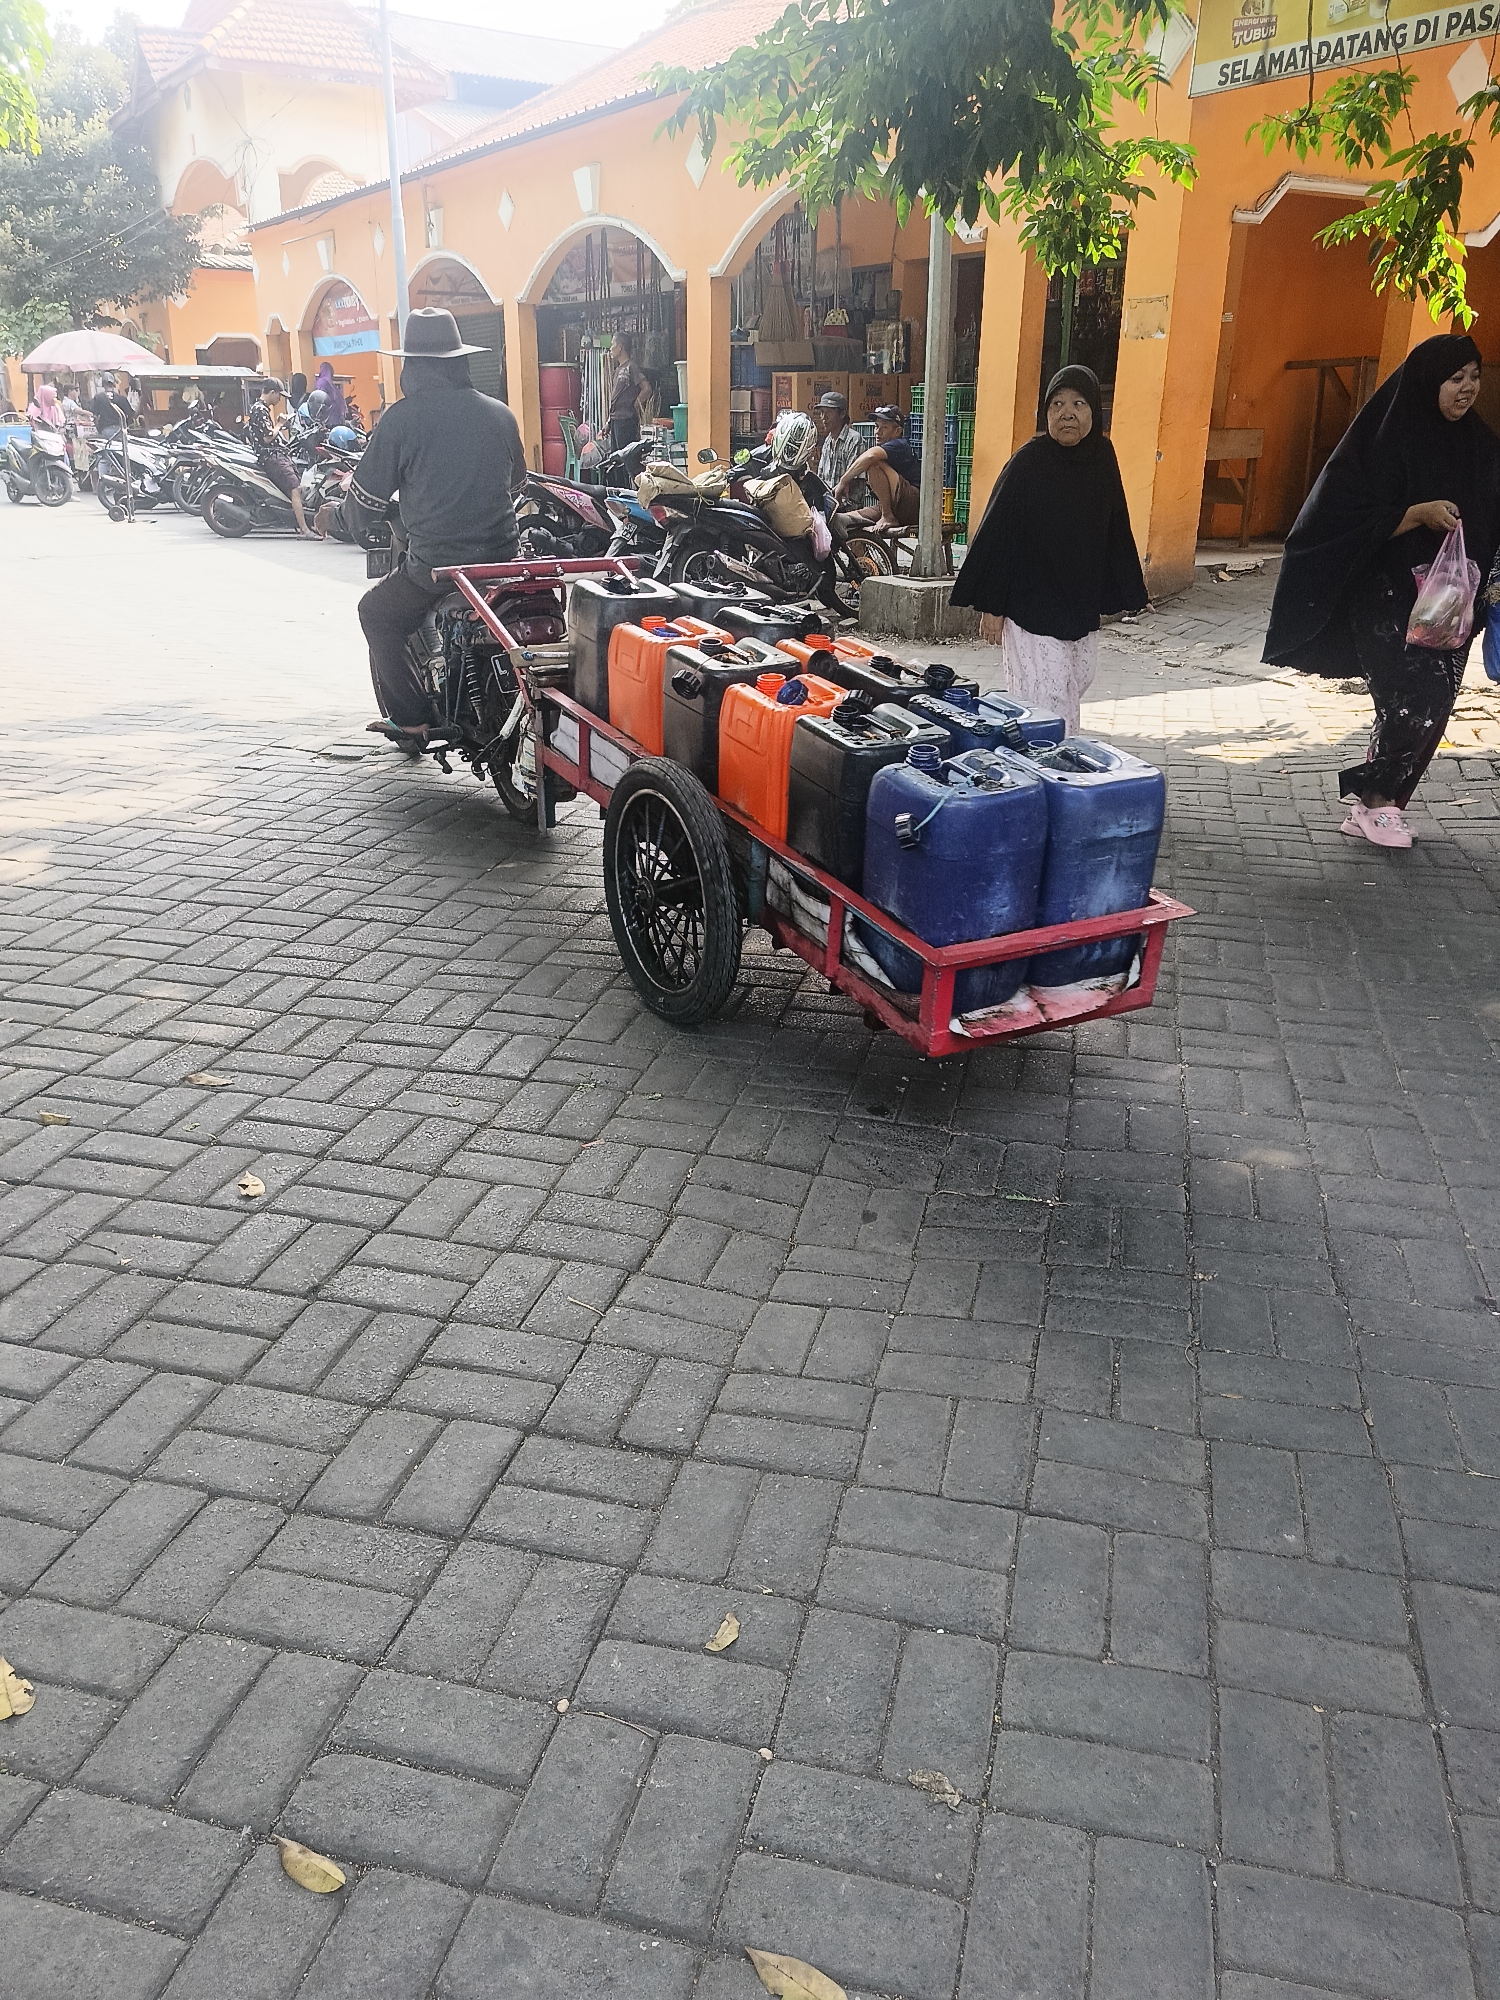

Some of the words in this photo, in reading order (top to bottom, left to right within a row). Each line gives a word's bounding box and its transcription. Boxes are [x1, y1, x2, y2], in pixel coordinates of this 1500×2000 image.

[1233, 17, 1259, 27] ENERGI
[1233, 25, 1277, 46] TUBUH
[1217, 44, 1311, 86] SELAMAT
[1315, 23, 1408, 66] DATANG
[1413, 15, 1440, 45] DI
